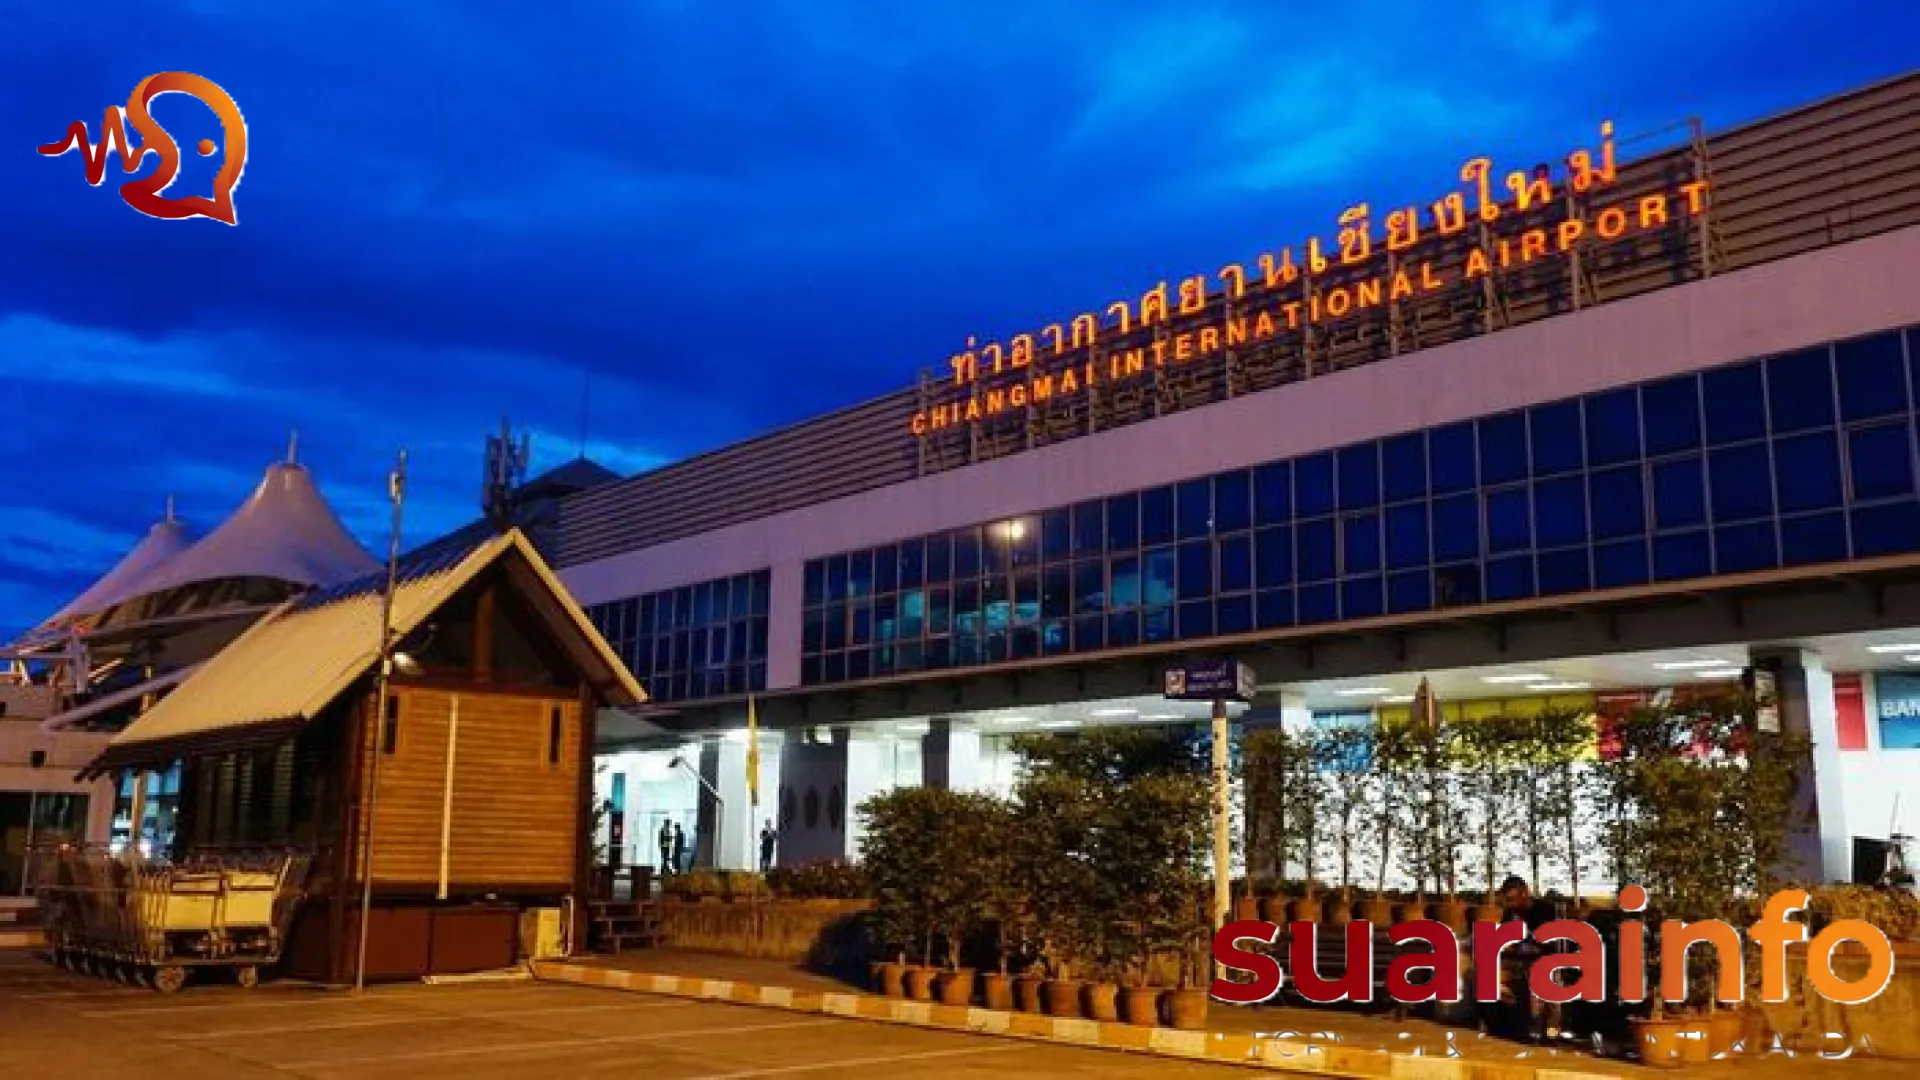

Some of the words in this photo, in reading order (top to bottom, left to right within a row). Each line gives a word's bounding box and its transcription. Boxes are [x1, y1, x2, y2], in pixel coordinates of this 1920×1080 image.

[911, 363, 1095, 435] CHIANGMAI
[1110, 261, 1442, 380] INTERNATIONAL
[1465, 180, 1709, 279] AIRPORT
